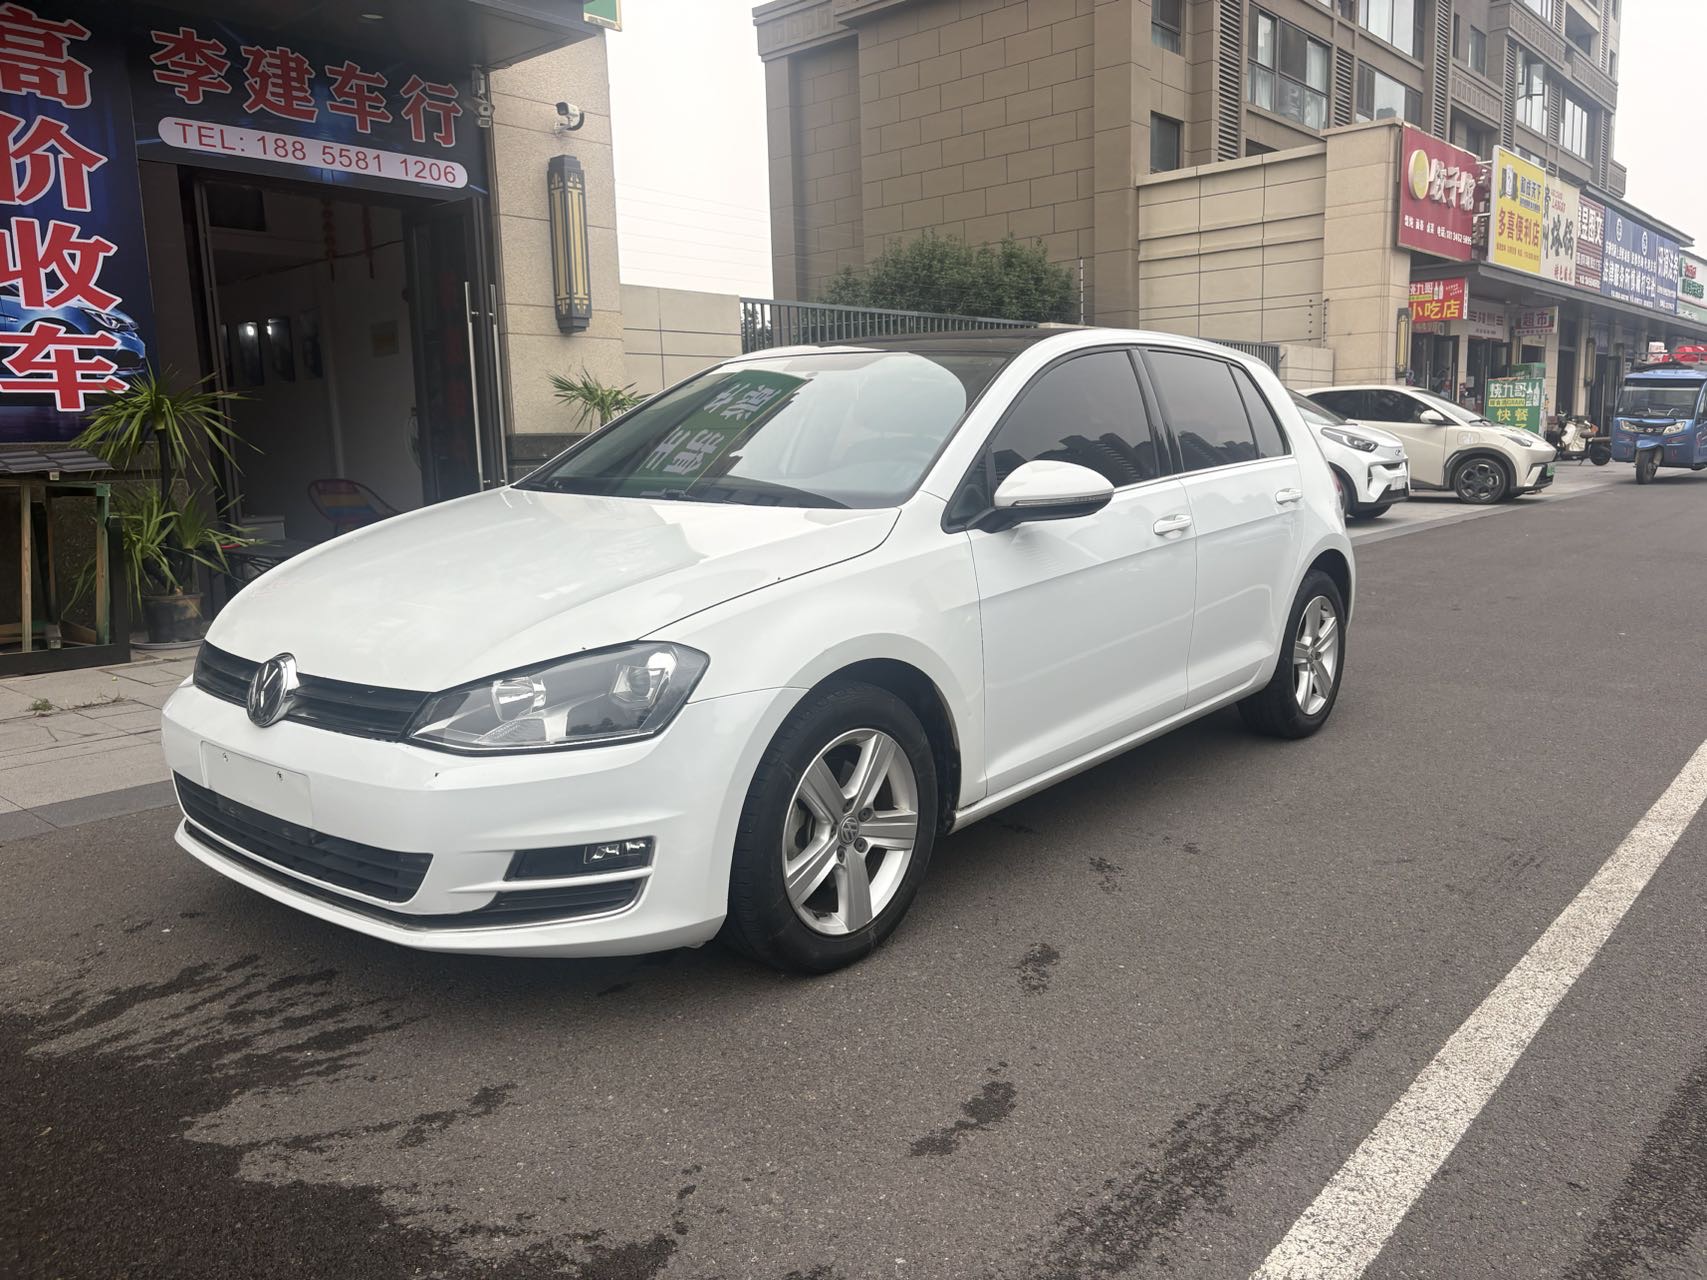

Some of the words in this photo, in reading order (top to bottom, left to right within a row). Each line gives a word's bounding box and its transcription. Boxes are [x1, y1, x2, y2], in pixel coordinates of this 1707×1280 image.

[150, 26, 463, 148] 李建车行
[174, 121, 246, 153] TEL:
[256, 135, 307, 162] 188
[321, 144, 384, 174] 5581
[399, 157, 458, 185] 1206
[0, 2, 130, 412] 高价收车
[1497, 206, 1541, 248] 多喜便利店
[1411, 299, 1461, 321] 小吃店
[1522, 311, 1549, 328] 超市
[1496, 408, 1529, 421] 快餐
